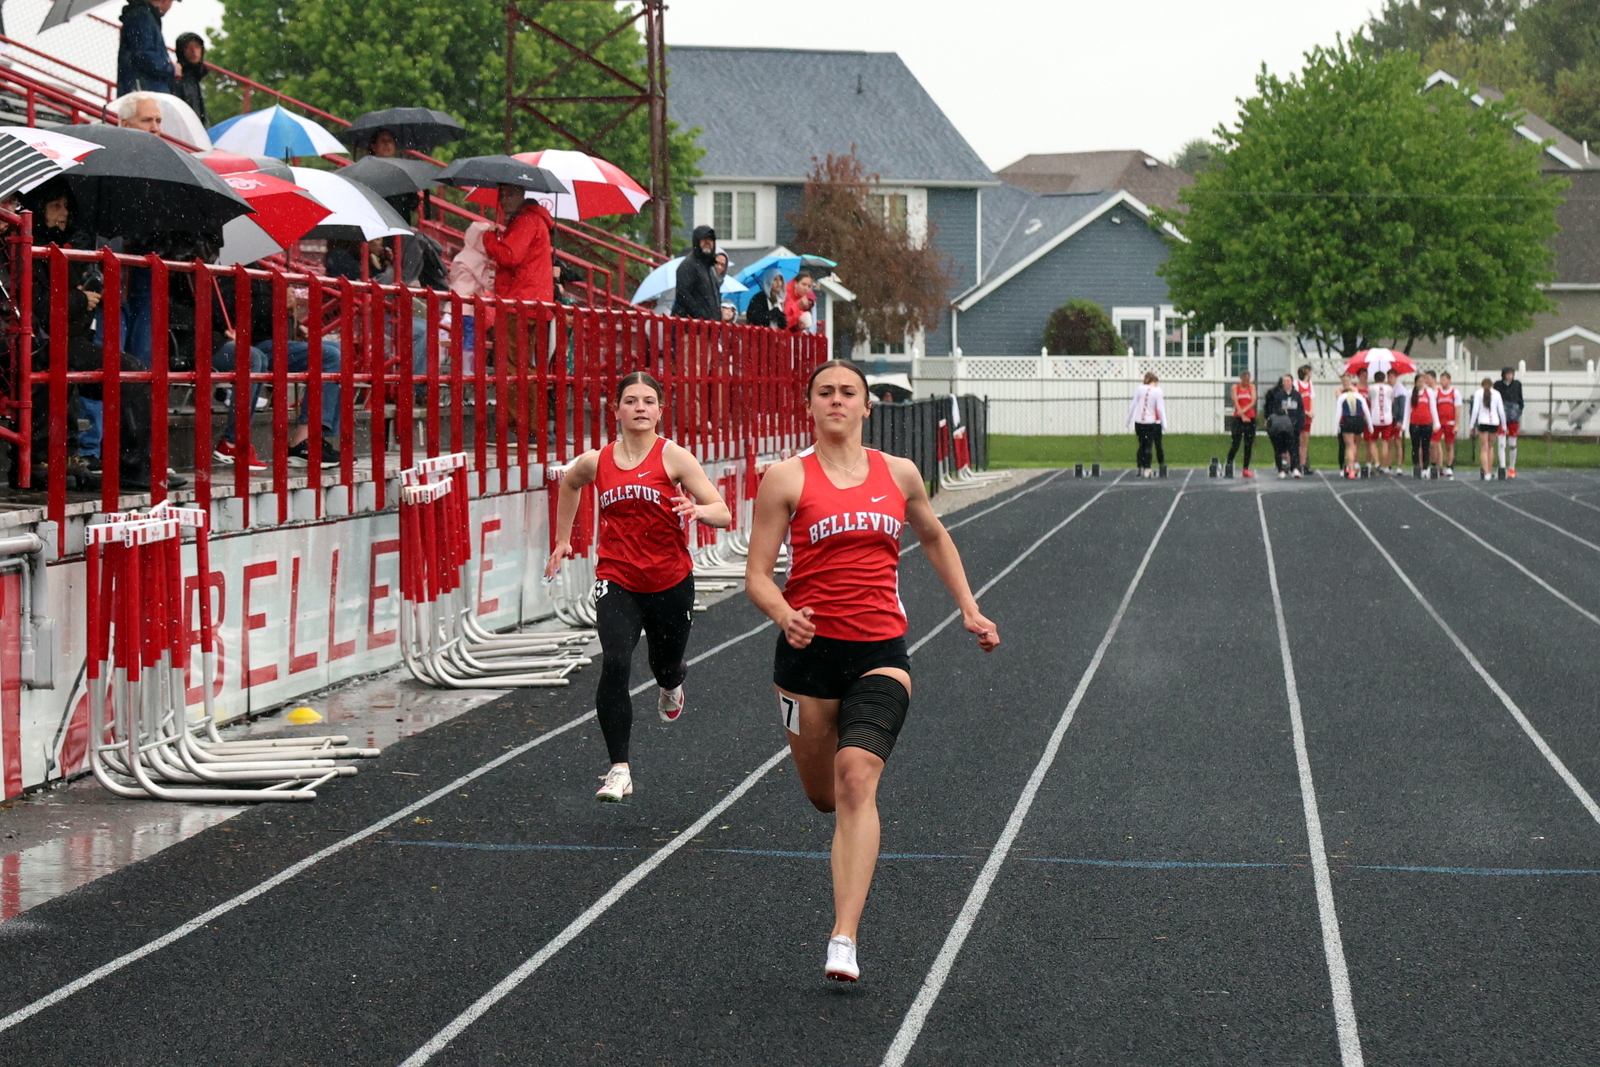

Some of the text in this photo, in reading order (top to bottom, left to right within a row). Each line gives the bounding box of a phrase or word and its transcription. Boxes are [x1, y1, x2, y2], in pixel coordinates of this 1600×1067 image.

[808, 511, 901, 545] BELLEVUE
[184, 519, 501, 706] BELLEE
[782, 697, 793, 728] 7
